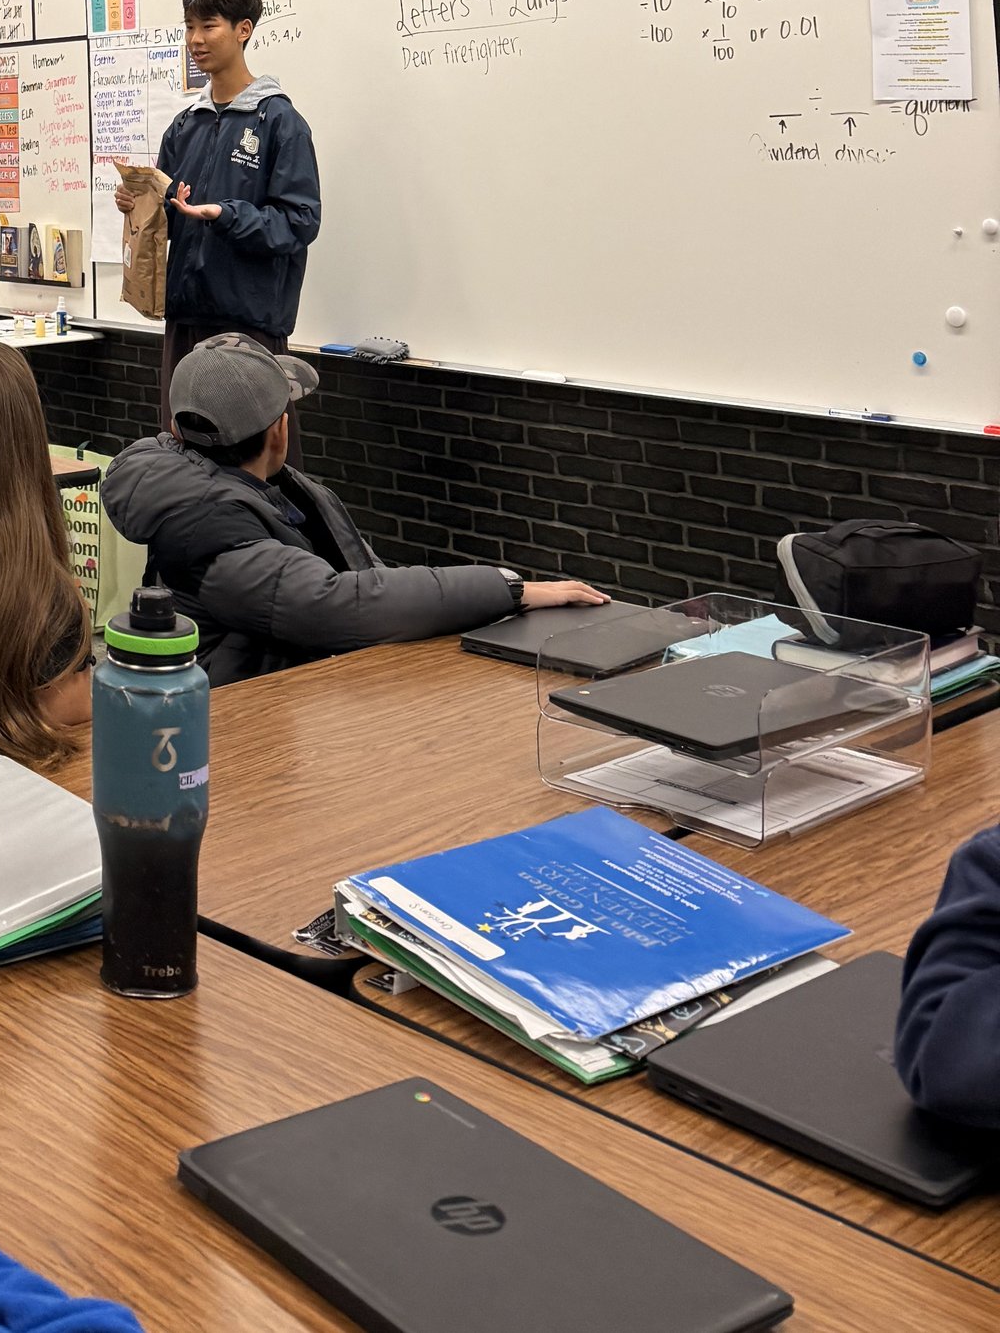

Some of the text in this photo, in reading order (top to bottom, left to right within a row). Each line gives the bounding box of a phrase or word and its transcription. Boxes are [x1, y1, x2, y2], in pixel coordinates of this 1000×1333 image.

[154, 29, 162, 45] 5
[750, 27, 768, 42] or
[780, 16, 819, 40] 0.01
[402, 36, 522, 75] Dear firefighter,
[713, 46, 735, 60] 100
[180, 774, 196, 788] CIL
[517, 871, 668, 948] John Golden
[536, 864, 685, 943] ELEMENTARY
